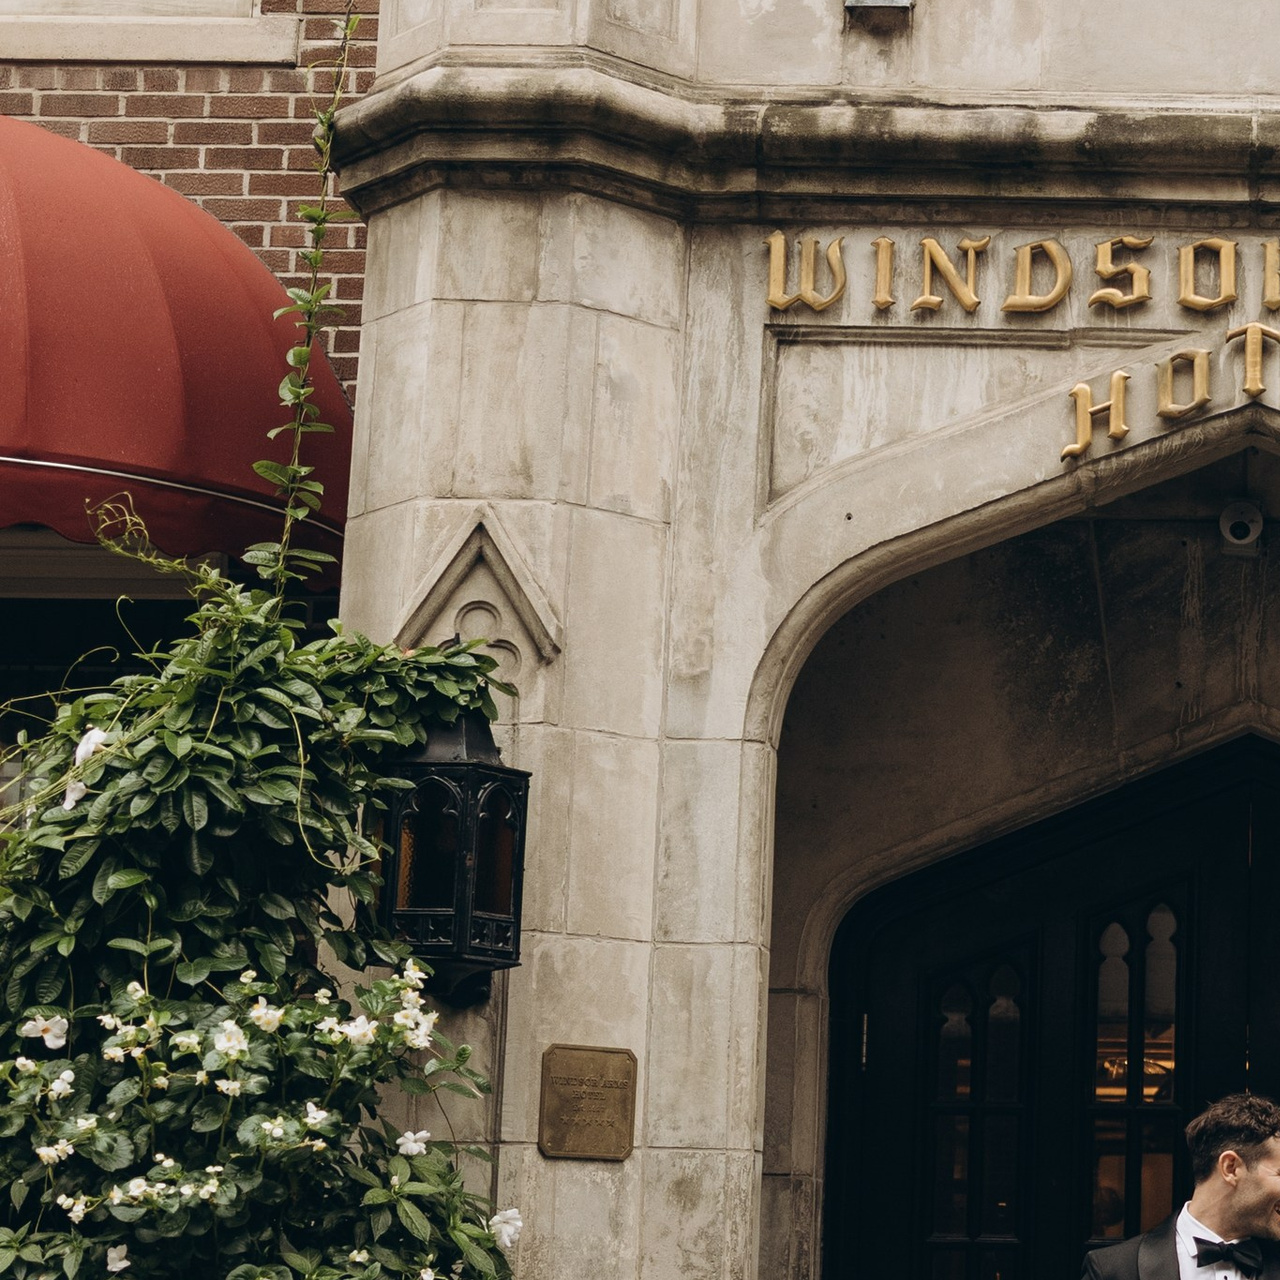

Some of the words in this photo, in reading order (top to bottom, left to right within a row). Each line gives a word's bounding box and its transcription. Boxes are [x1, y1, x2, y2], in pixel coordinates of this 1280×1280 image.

[551, 1076, 598, 1087] WINDSOR
[600, 1079, 630, 1090] ARMS
[572, 1090, 606, 1101] HOTEL
